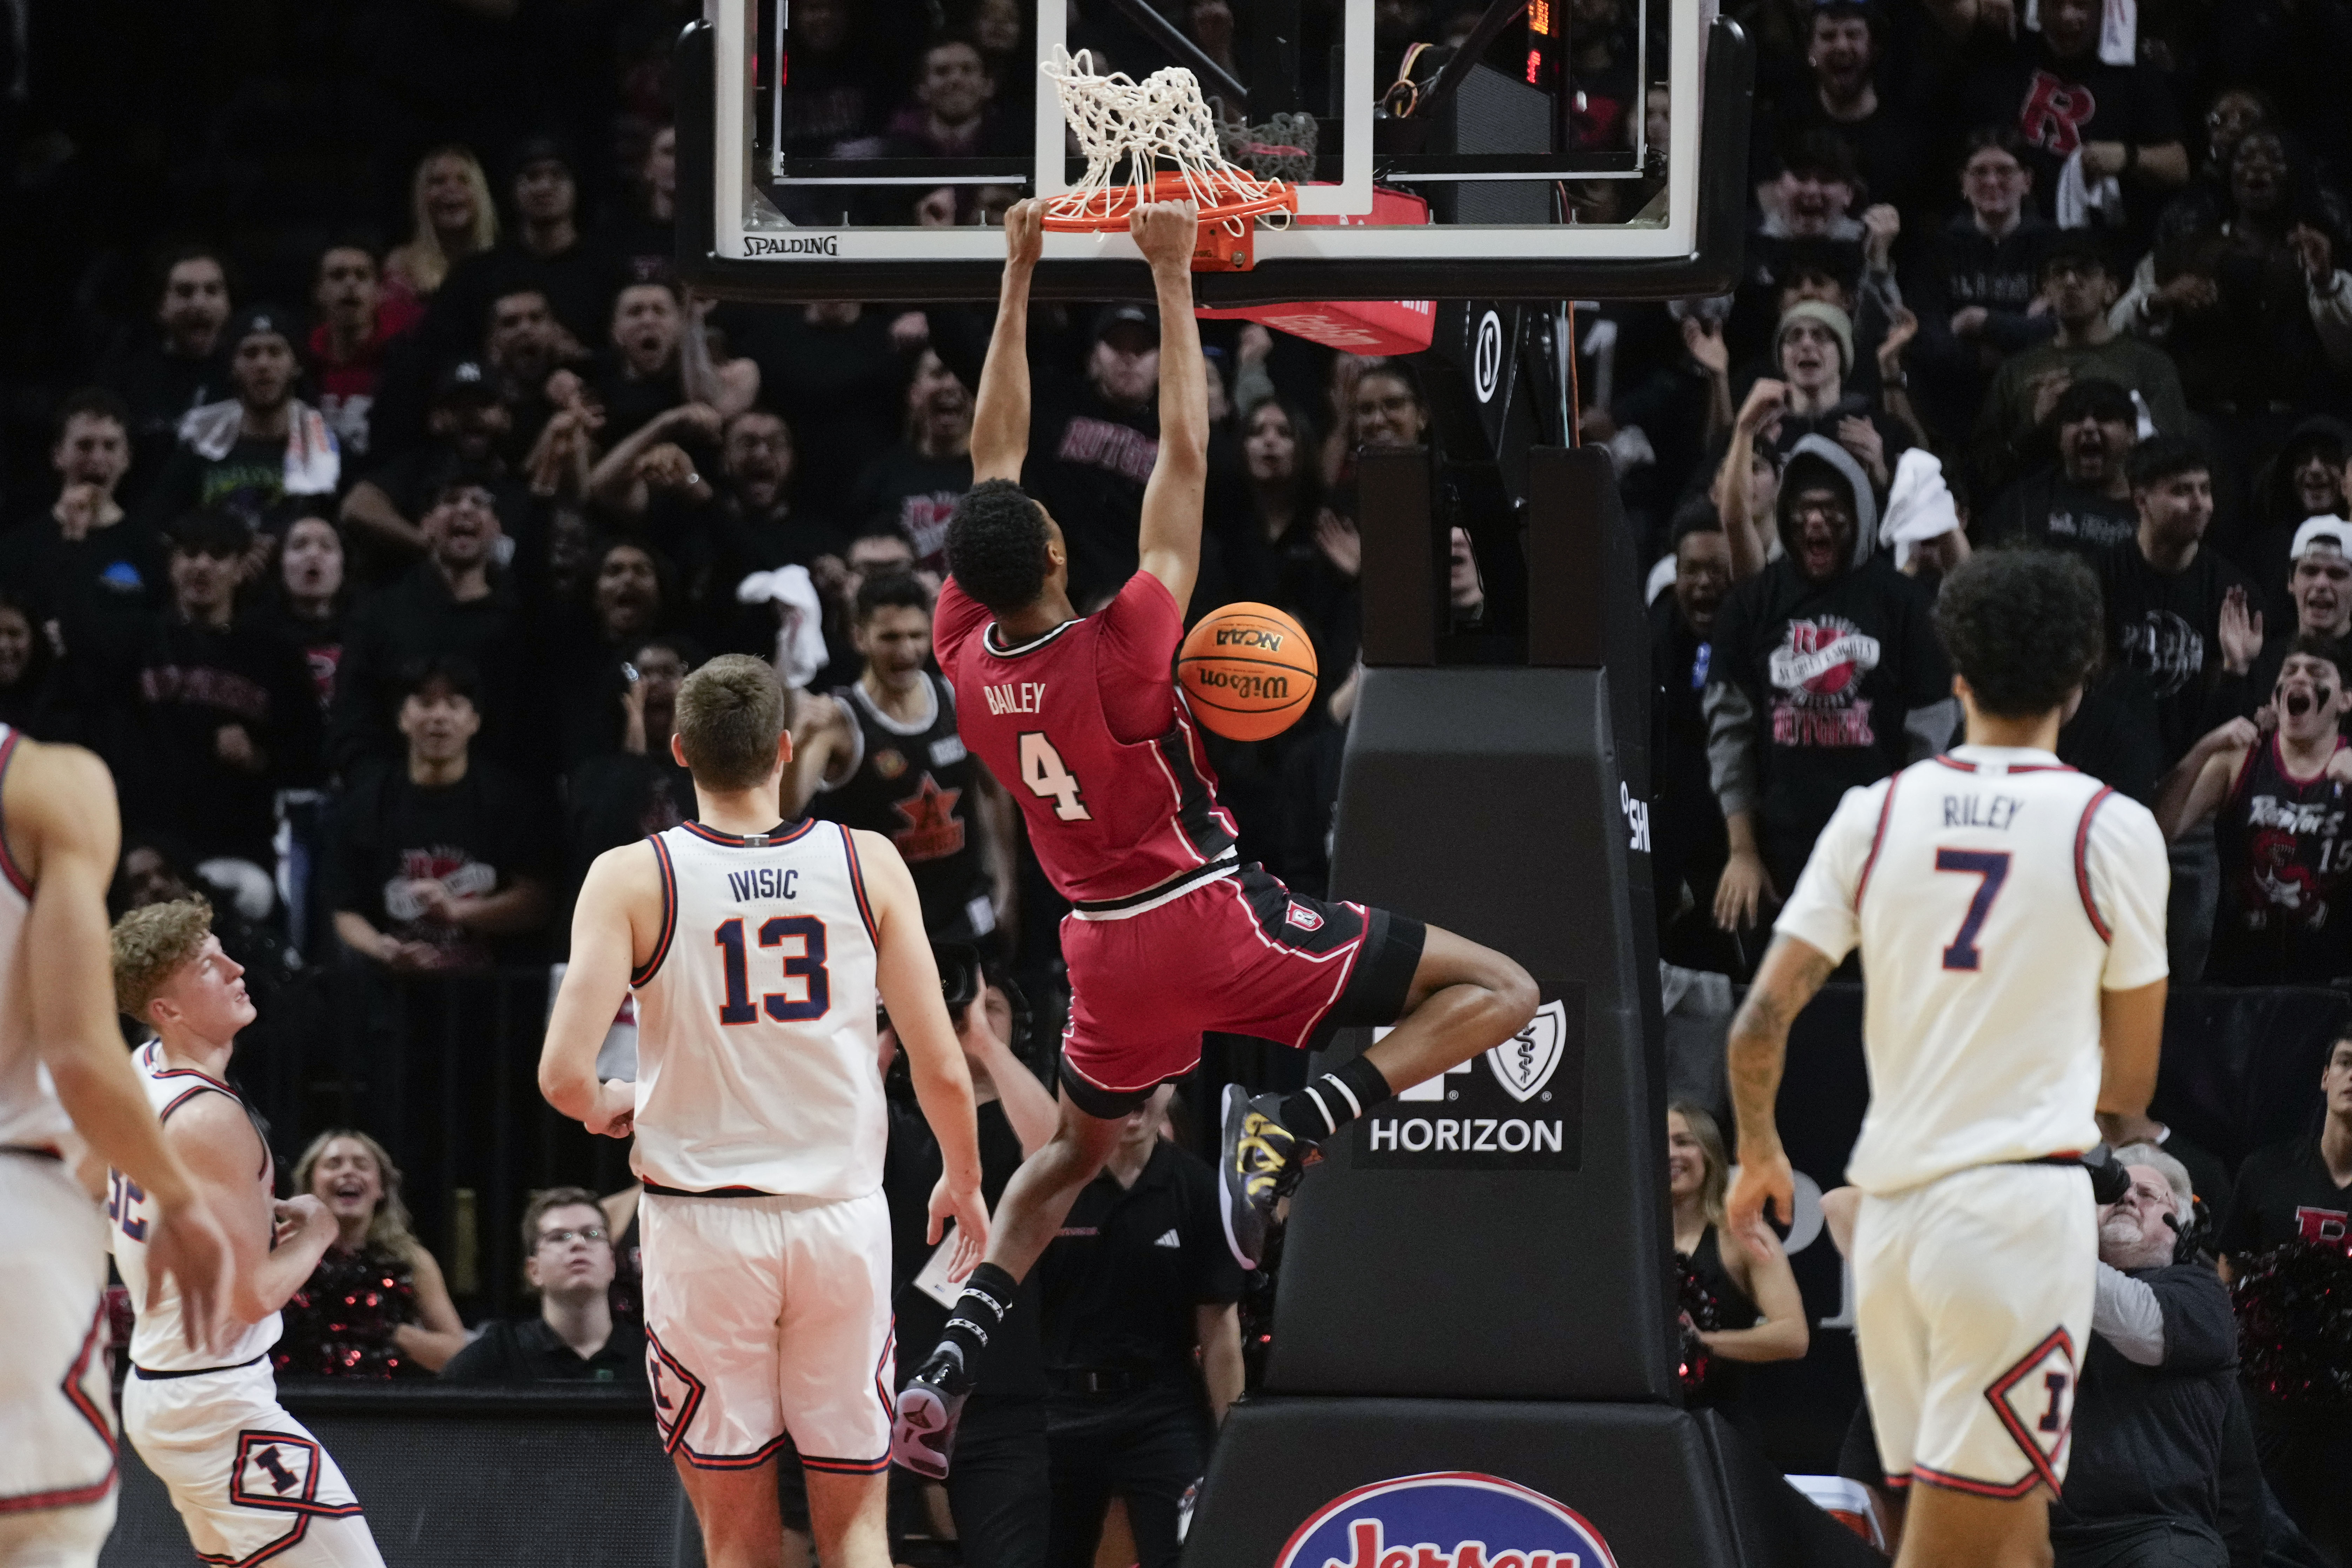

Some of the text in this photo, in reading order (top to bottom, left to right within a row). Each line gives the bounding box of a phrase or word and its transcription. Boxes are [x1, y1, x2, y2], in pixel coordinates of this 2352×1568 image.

[2021, 70, 2096, 156] R
[744, 234, 838, 257] SPALDING
[1216, 629, 1284, 652] NCAA
[983, 682, 1046, 715] BAILEY
[1198, 667, 1289, 699] Wilson
[1017, 731, 1094, 821] 4
[1629, 798, 1651, 853] SHI
[1943, 794, 2025, 830] RILEY
[728, 868, 798, 903] IVISIC
[1934, 847, 2015, 972] 7
[715, 914, 831, 1026] 13
[1370, 1118, 1563, 1152] HORIZON
[254, 1444, 300, 1495] I
